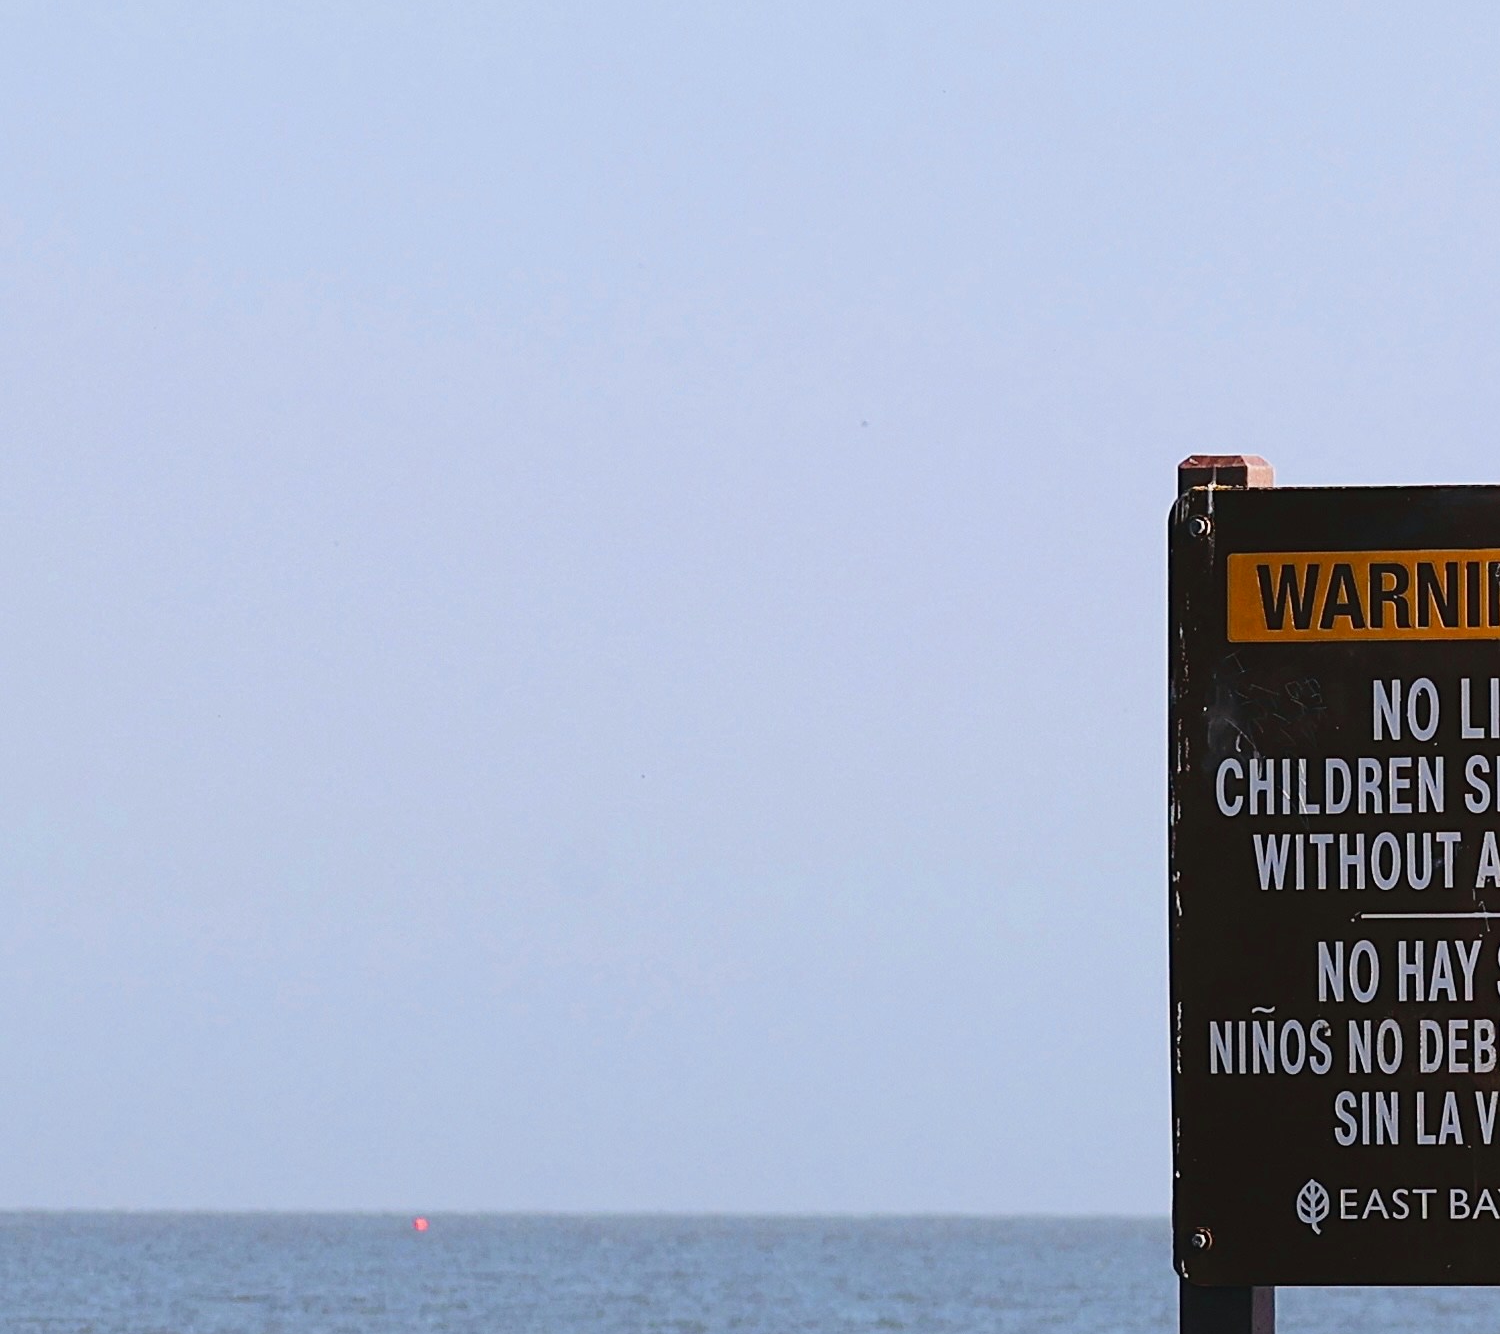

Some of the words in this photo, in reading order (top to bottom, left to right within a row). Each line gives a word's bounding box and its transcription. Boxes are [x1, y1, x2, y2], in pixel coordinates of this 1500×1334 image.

[1373, 677, 1440, 742] NO
[1215, 756, 1445, 817] CHILDREN
[1252, 831, 1462, 891] WITHOUT
[1318, 939, 1380, 1003] NO
[1398, 939, 1483, 1002] HAY
[1209, 1006, 1333, 1075] NIÑOS
[1348, 1018, 1403, 1075] NO
[1334, 1090, 1399, 1147] SIN
[1416, 1091, 1464, 1145] LA
[1340, 1188, 1438, 1220] EAST
